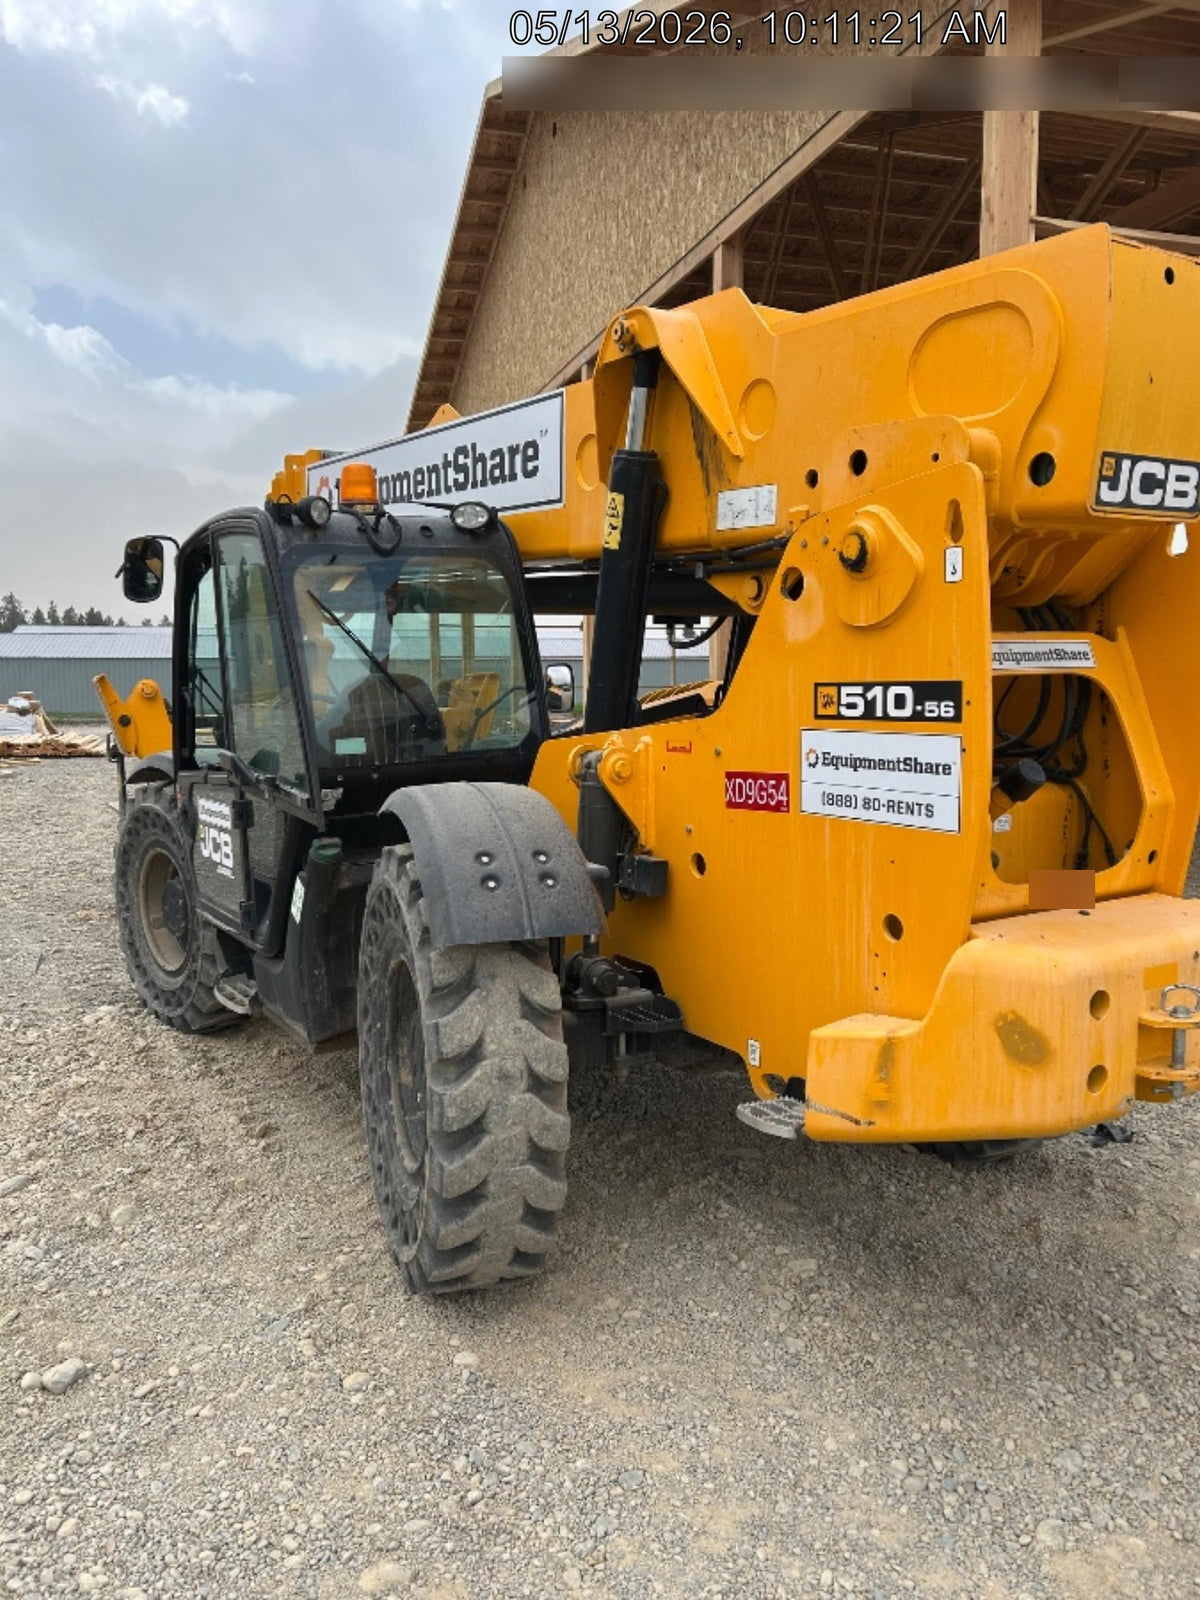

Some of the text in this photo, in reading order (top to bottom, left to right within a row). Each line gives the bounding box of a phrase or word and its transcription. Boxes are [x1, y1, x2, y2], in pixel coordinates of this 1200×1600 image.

[336, 437, 539, 506] pmentShare
[1099, 458, 1199, 508] JCB
[992, 648, 1091, 666] quipmentShare
[838, 685, 955, 718] 510-56
[821, 751, 952, 776] EquipmentShare
[725, 778, 788, 806] XD9G54
[821, 790, 857, 810] (888)
[201, 826, 233, 868] JCB
